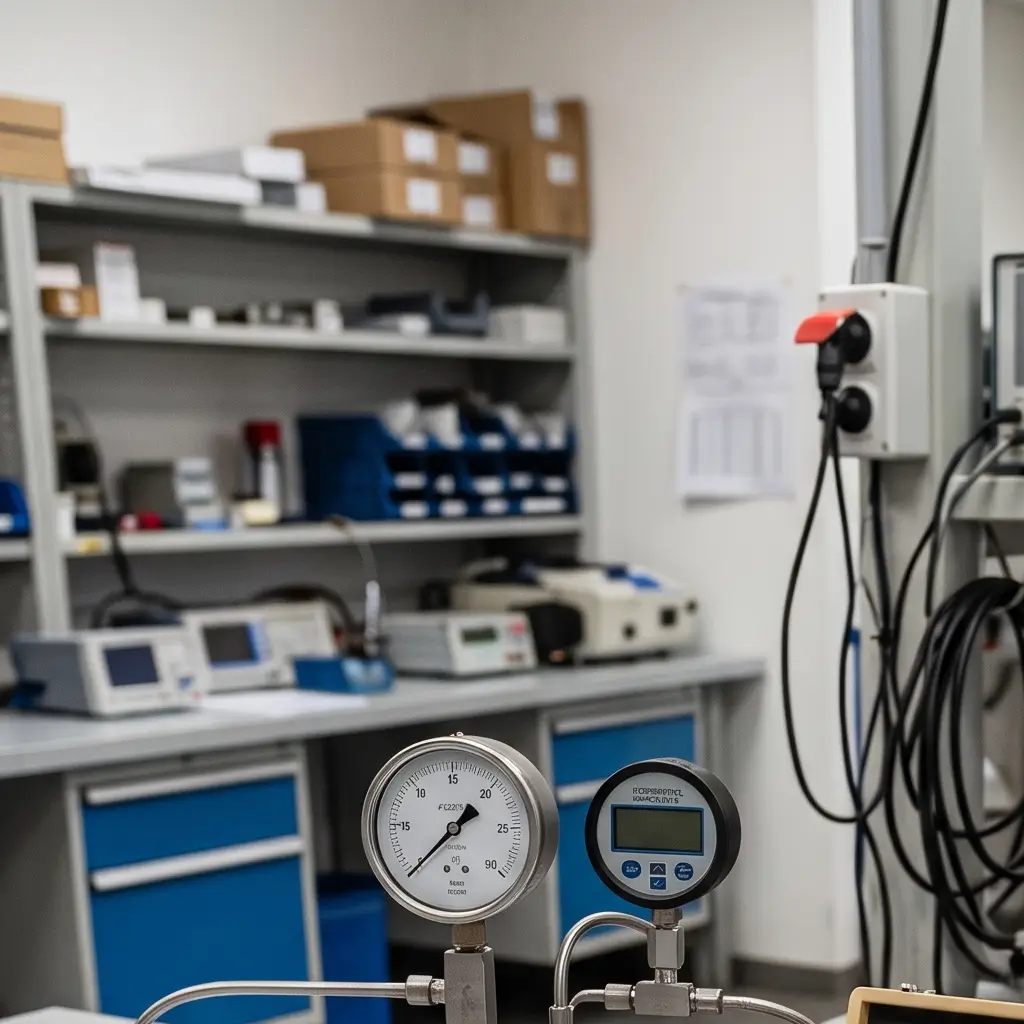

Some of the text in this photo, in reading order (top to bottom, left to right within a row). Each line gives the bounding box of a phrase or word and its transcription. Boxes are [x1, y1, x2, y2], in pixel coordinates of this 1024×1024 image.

[447, 774, 459, 785] 15
[416, 788, 426, 798] 10
[479, 789, 492, 799] 20
[497, 823, 509, 834] 25
[485, 859, 497, 870] 90
